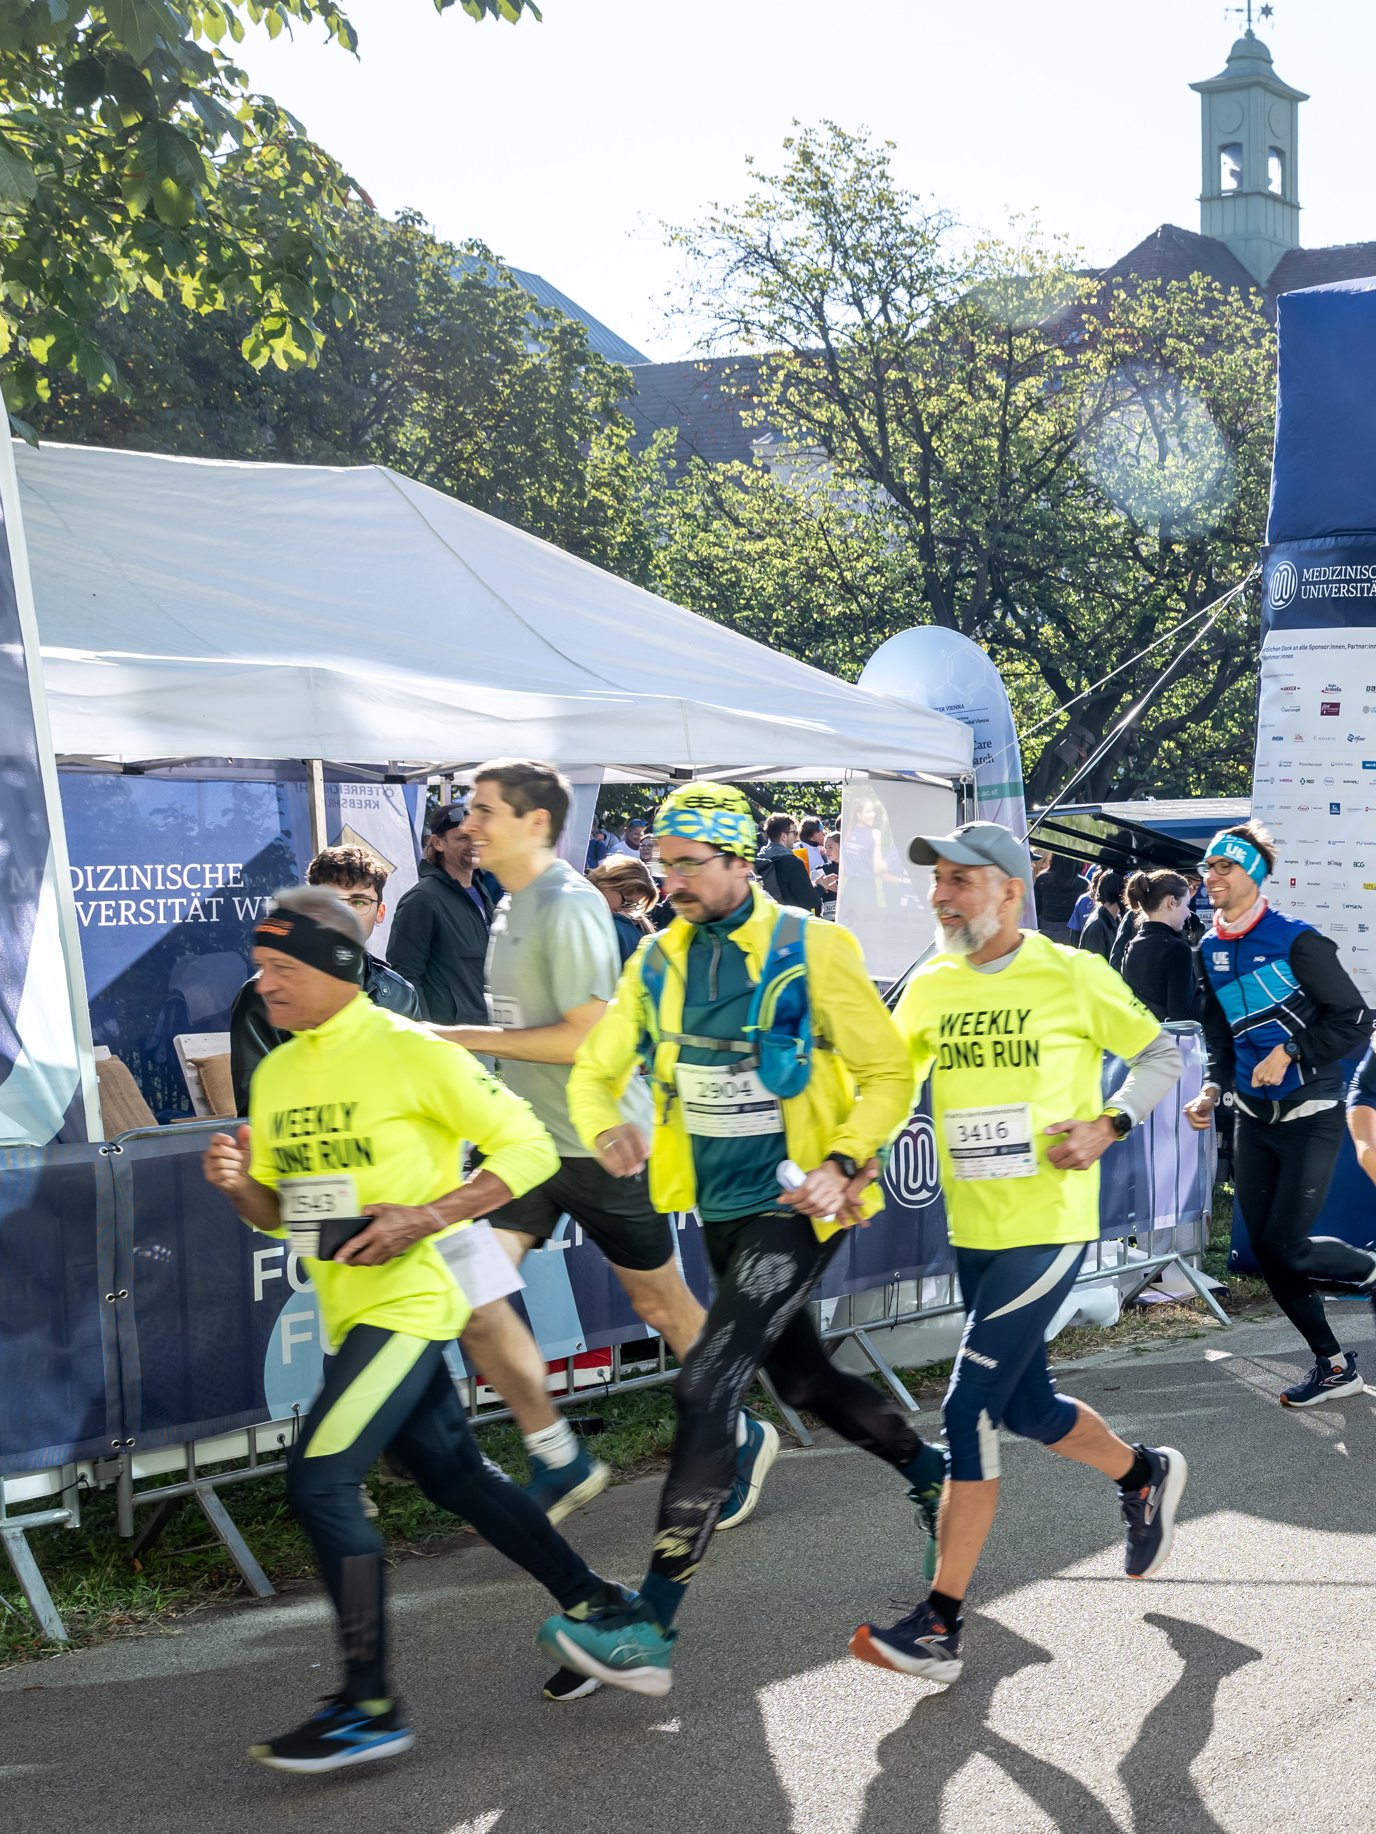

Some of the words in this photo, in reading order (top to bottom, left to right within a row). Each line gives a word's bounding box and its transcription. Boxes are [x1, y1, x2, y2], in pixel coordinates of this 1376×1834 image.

[1308, 643, 1347, 651] Sponsor:innen,
[946, 704, 965, 712] VIENNA
[1353, 861, 1365, 869] BCG
[940, 1008, 1032, 1037] WEEKLY
[992, 1039, 1040, 1068] RUN
[696, 1080, 755, 1099] 2904
[956, 1121, 1009, 1143] 3416
[319, 1136, 375, 1169] RUN
